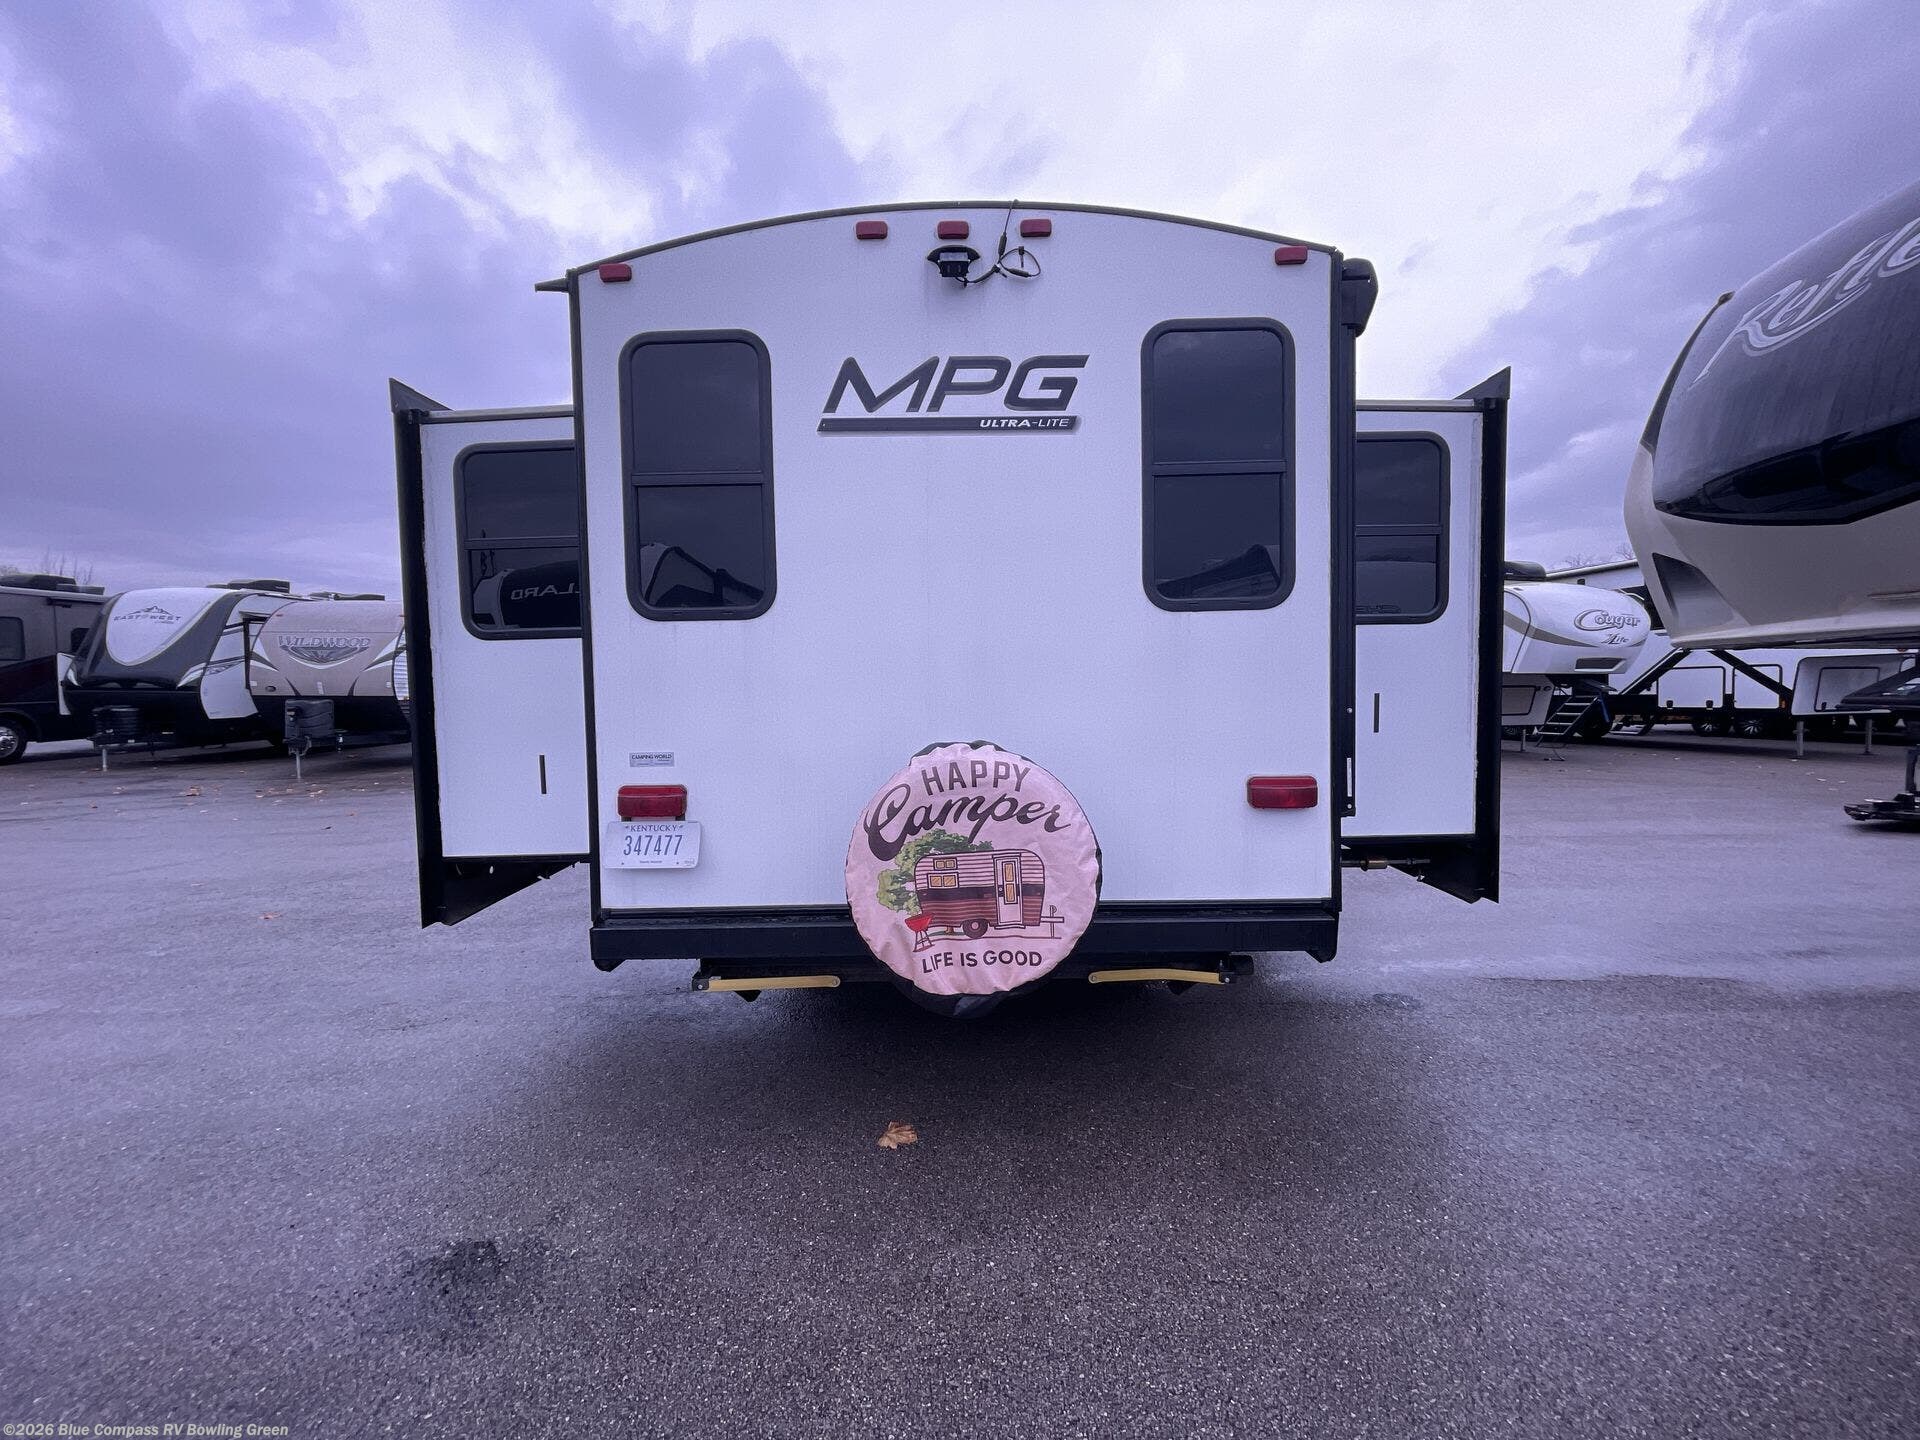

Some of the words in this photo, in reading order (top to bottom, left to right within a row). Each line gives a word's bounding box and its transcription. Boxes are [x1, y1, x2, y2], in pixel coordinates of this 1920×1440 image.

[822, 354, 1091, 414] MPG
[979, 418, 1070, 429] ULTRA-LITE
[1574, 609, 1641, 632] Cougar
[920, 759, 1031, 796] HAPPY
[630, 824, 678, 832] KENTUCKY
[863, 782, 1072, 862] Camper
[623, 834, 683, 856] 347477
[921, 951, 954, 974] LIFE
[960, 951, 978, 968] IS
[983, 949, 1043, 967] GOOD
